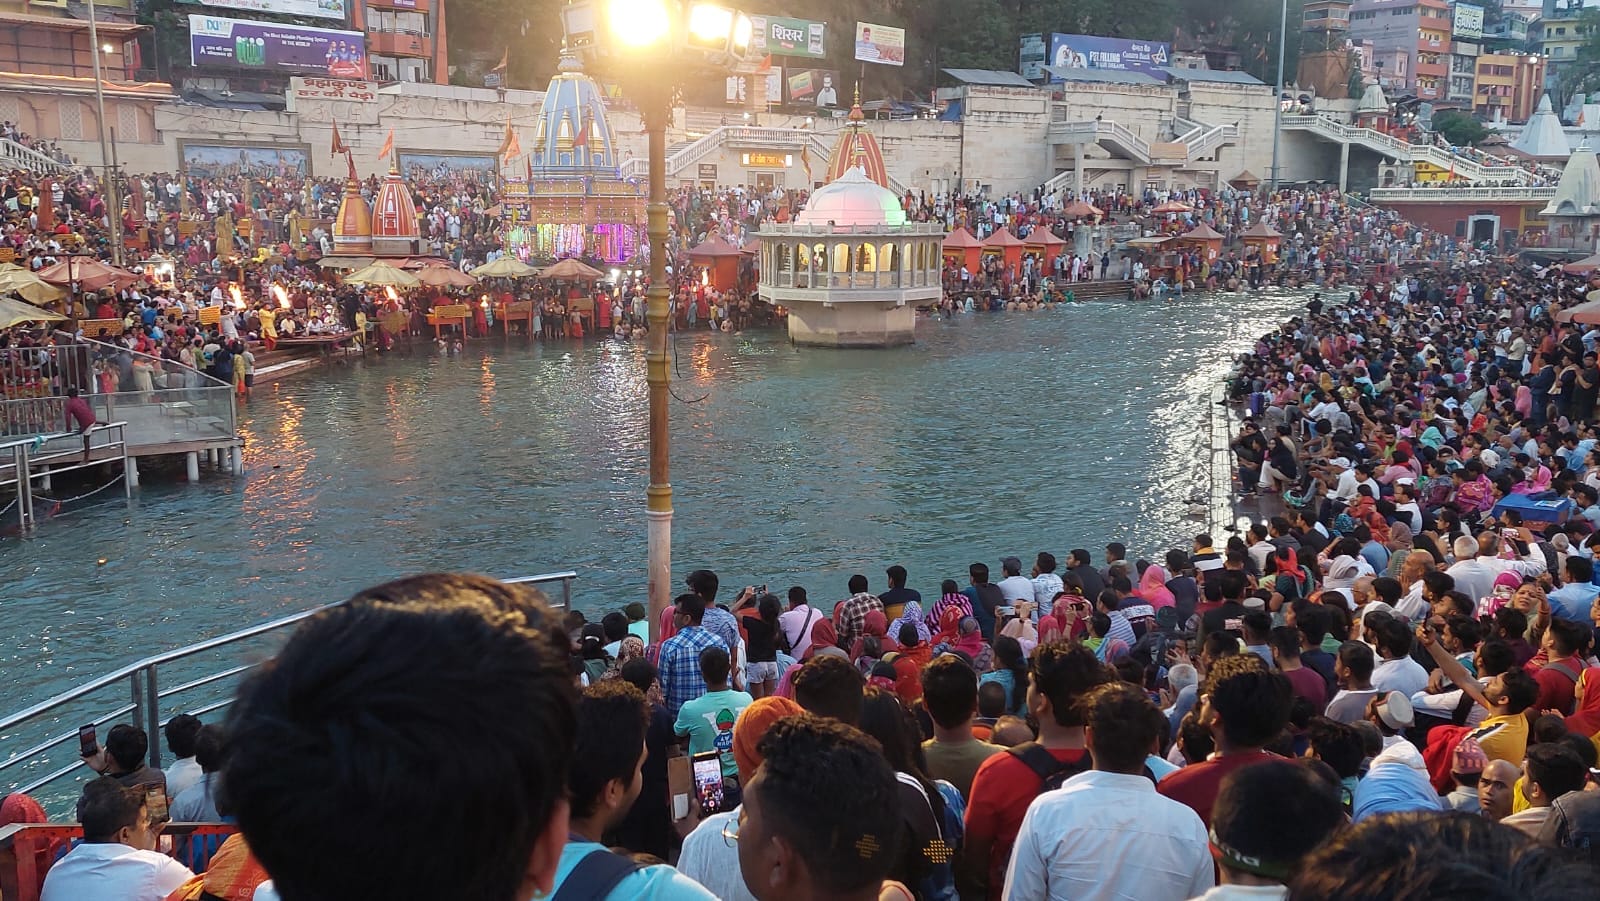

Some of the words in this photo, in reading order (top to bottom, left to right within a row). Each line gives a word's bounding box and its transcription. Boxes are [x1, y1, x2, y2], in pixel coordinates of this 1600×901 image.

[1456, 16, 1482, 32] GANGA
[772, 23, 804, 42] शिखर
[297, 89, 320, 97] हर
[323, 89, 344, 98] की
